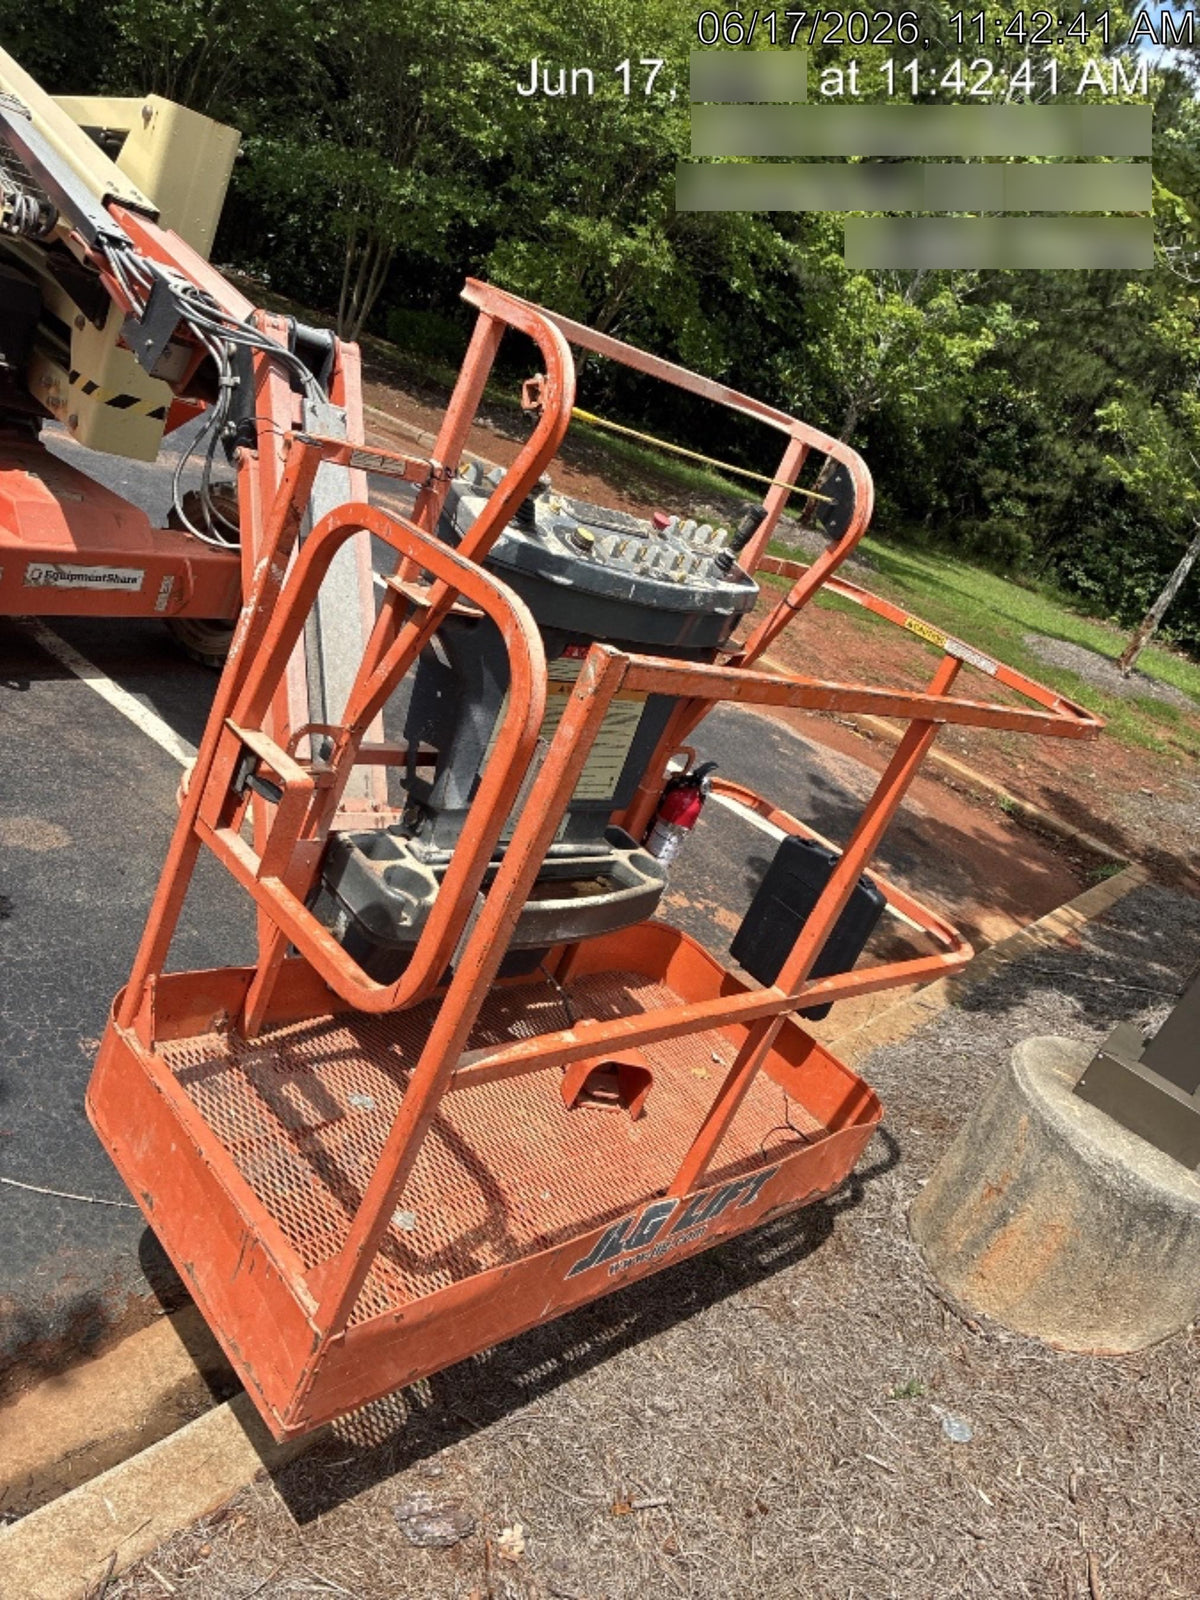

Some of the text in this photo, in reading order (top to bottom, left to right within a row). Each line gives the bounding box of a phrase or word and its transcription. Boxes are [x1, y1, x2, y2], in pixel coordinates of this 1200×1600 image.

[43, 569, 138, 585] EquipmentShare
[564, 1164, 783, 1280] JLG LIFT
